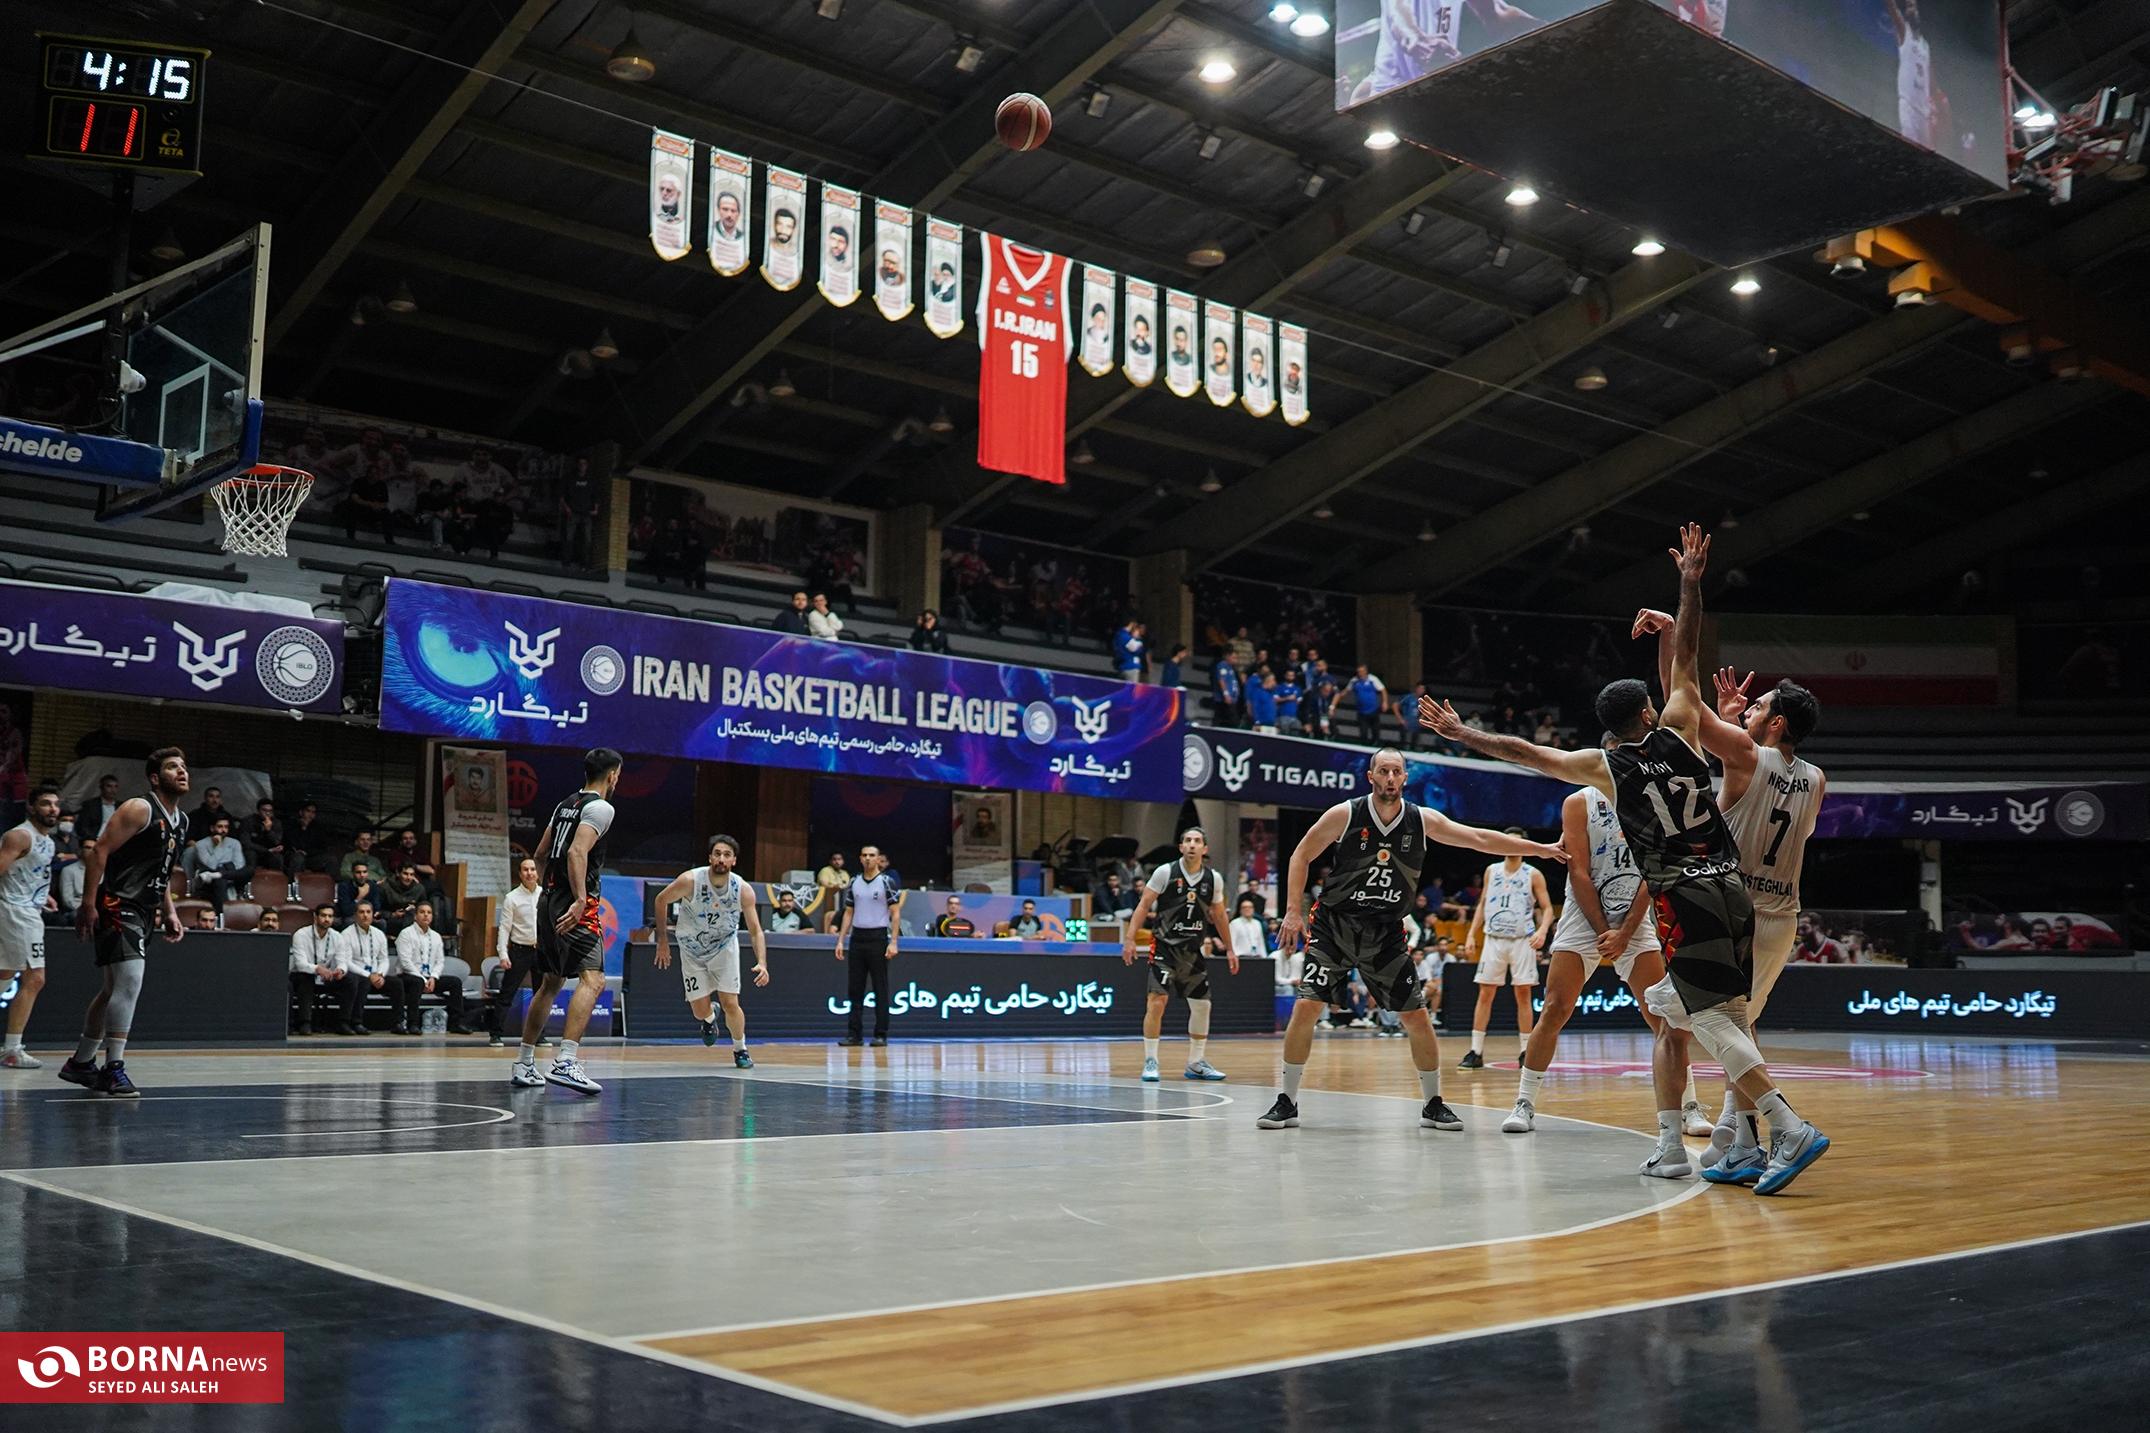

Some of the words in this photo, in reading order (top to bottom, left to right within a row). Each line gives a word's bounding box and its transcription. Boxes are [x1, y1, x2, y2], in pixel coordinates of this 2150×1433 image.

[83, 51, 191, 100] 4:15
[80, 103, 139, 157] 11
[158, 147, 184, 158] TETA
[1010, 339, 1040, 379] 15
[0, 431, 83, 463] helde
[632, 655, 711, 703] IRAN
[722, 666, 908, 726] BASKETBALL
[916, 690, 1019, 738] LEAGUE
[717, 718, 770, 743] بسکتبال
[770, 724, 795, 745] ملی
[1259, 763, 1356, 791] TIGARD
[1642, 776, 1712, 838] 12
[1763, 808, 1791, 868] 7
[1614, 847, 1631, 868] 14
[1366, 866, 1393, 888] 25
[685, 976, 699, 993] 32
[1160, 971, 1169, 985] 7
[1303, 962, 1331, 987] 25
[889, 981, 937, 1015] های
[942, 985, 982, 1019] تیم
[985, 983, 1050, 1016] حامی
[1052, 981, 1113, 1015] تیگارد
[1848, 990, 1881, 1014] ملی
[1883, 991, 1920, 1015] های
[1921, 994, 1951, 1018] تیم
[1952, 991, 2003, 1017] حامی
[2004, 990, 2056, 1018] تیگارد
